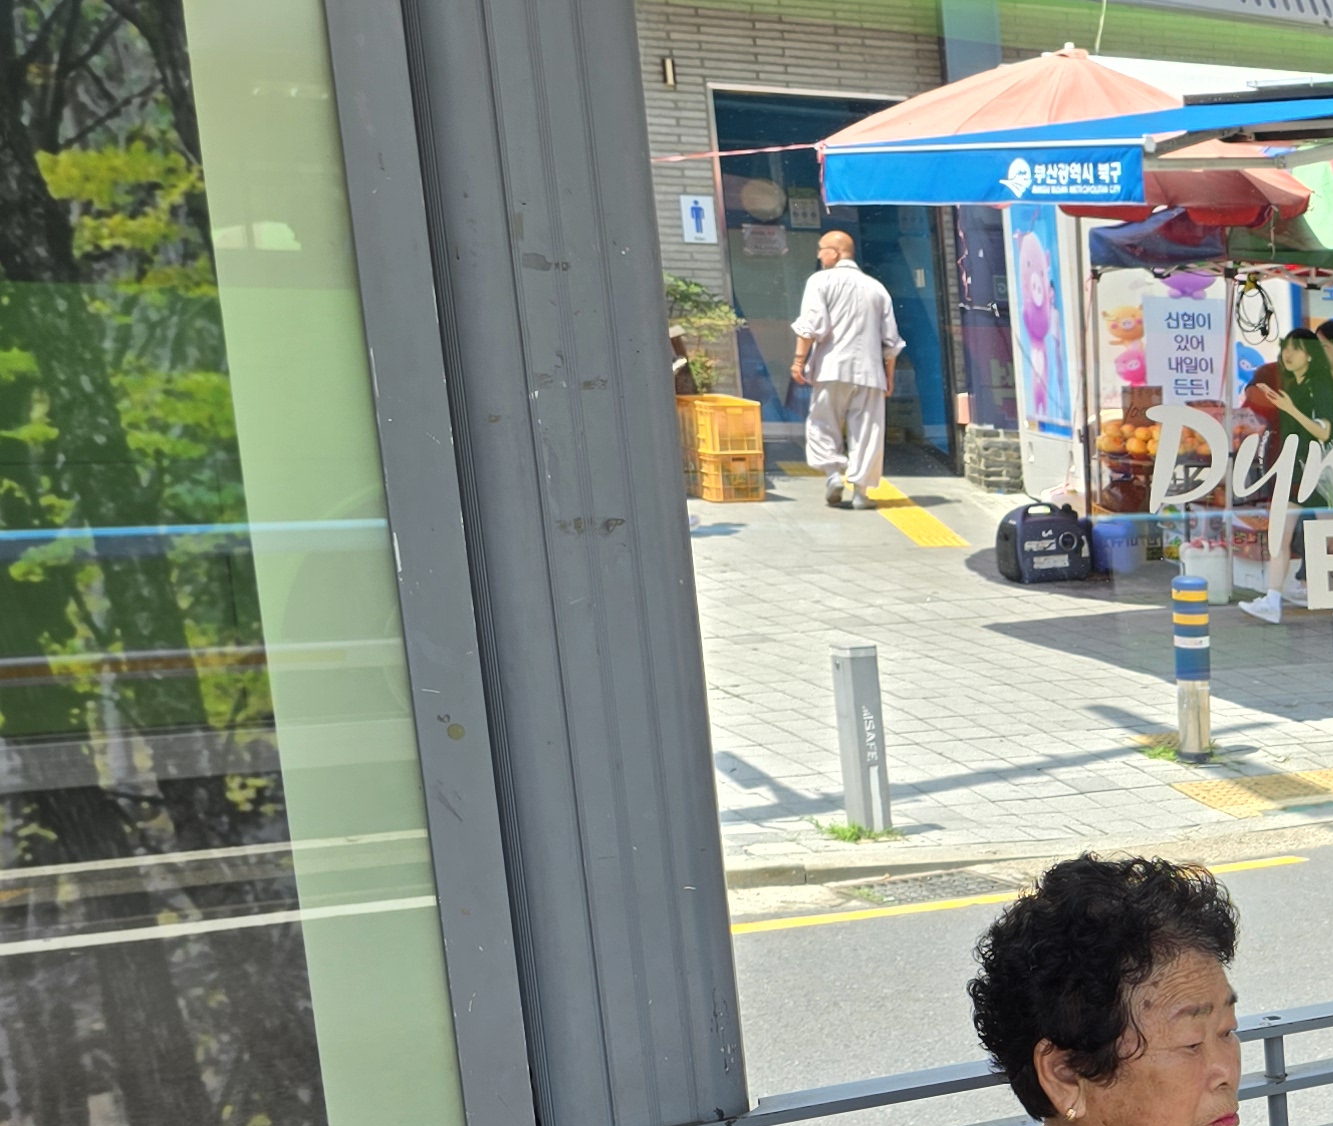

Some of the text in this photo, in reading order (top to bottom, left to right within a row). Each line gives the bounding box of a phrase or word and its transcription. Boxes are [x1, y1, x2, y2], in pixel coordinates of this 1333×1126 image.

[1034, 161, 1122, 185] 부산광역시 북구
[1165, 311, 1211, 330] 신협이
[1174, 334, 1205, 352] 있어
[1168, 357, 1213, 374] 내일이
[1173, 379, 1209, 396] 든든!
